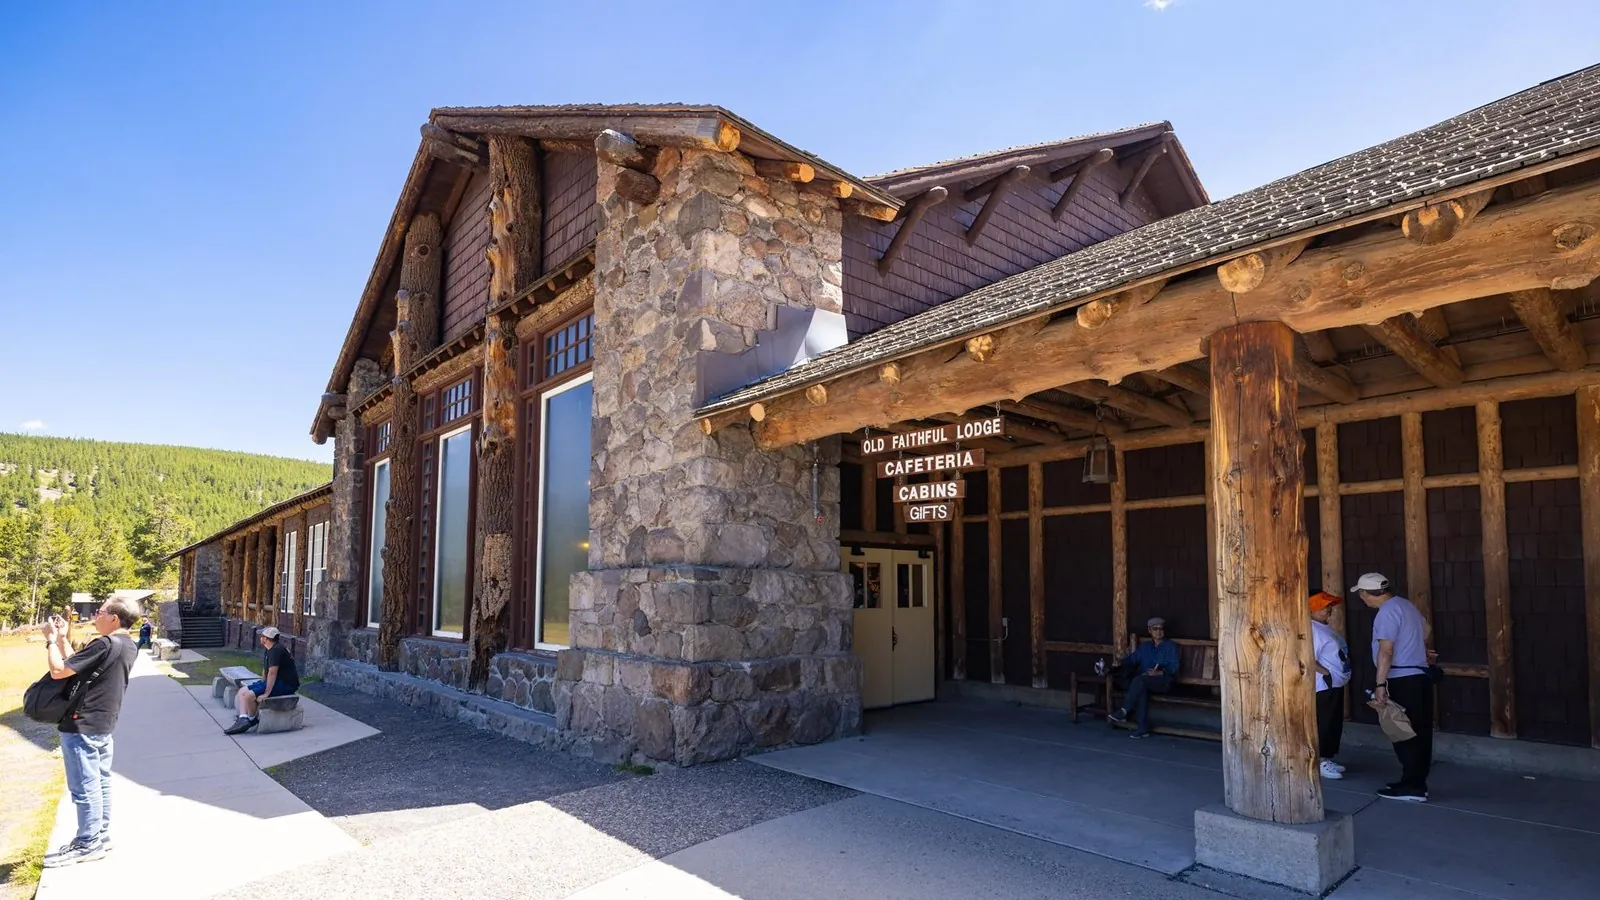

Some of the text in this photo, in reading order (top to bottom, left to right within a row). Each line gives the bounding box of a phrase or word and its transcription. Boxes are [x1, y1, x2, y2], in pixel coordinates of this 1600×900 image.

[864, 418, 1000, 454] OLD FAITHFUL LODGE
[885, 452, 974, 476] CAFETERIA
[899, 482, 957, 500] CABINS
[910, 505, 947, 520] GIFTS
